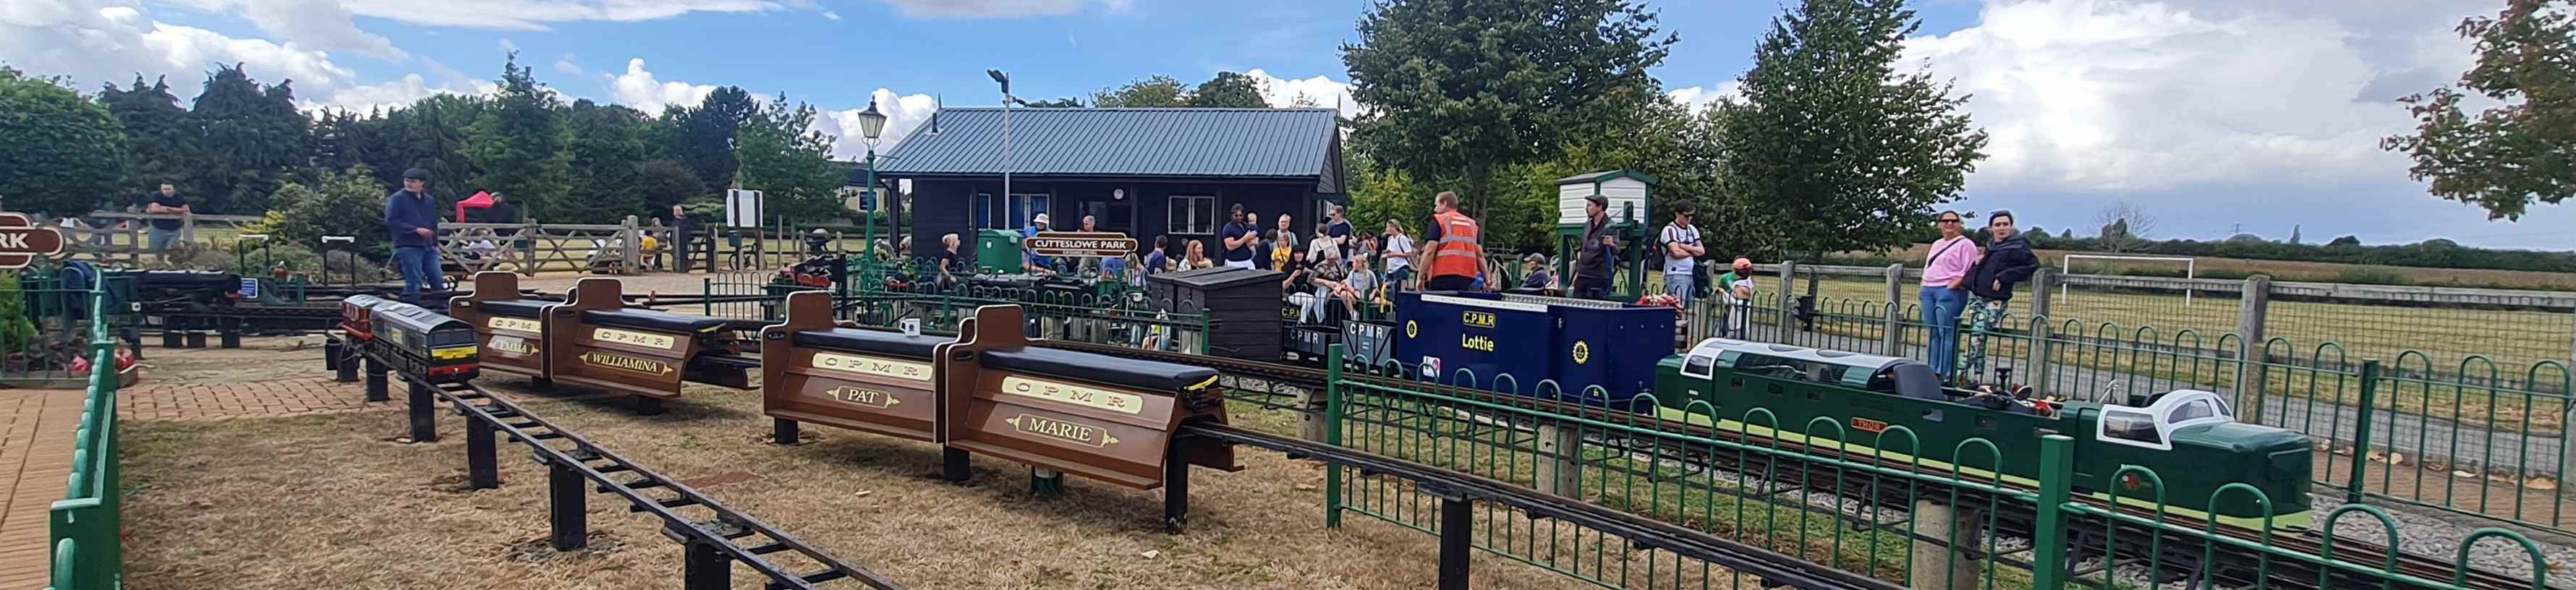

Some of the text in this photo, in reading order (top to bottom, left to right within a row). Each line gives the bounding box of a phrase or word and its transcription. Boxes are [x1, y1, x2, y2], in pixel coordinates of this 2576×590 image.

[1035, 239, 1126, 249] CUTTESLOWE PARK
[1462, 333, 1495, 351] Lottie
[593, 353, 658, 372] WILLIAMINA
[847, 388, 879, 403] PAT
[1029, 417, 1093, 442] MARIE
